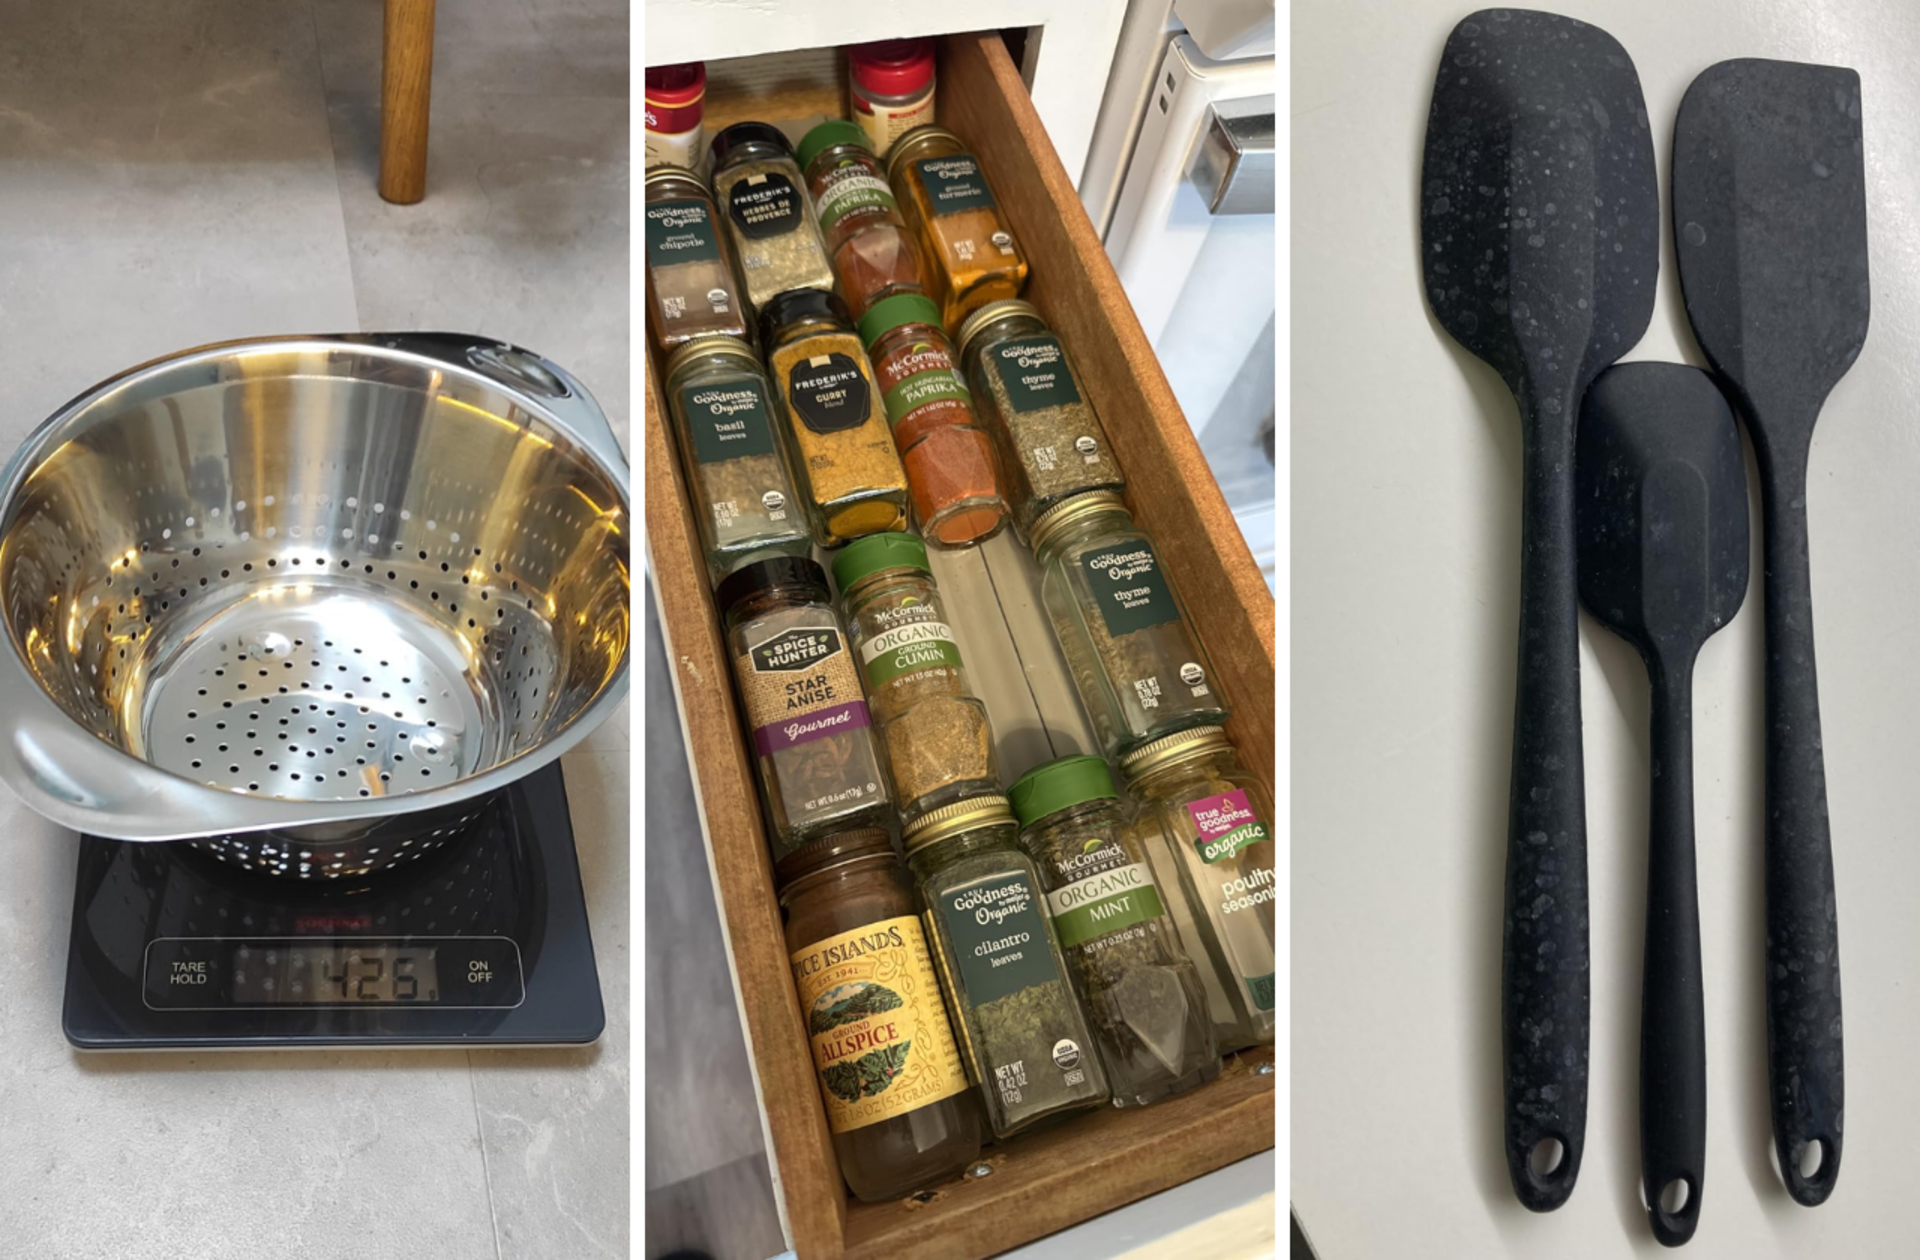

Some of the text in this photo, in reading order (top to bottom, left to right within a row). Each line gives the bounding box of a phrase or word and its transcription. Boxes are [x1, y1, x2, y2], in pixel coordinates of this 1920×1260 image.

[734, 186, 791, 206] FREDERIK'S
[821, 178, 876, 206] ORGANIC
[939, 188, 981, 200] turmeric
[778, 199, 790, 208] DE
[834, 193, 881, 214] PAPRIKA
[747, 208, 791, 225] PROVENCE
[659, 239, 705, 250] chipotle
[1001, 345, 1053, 358] Goodness
[886, 349, 950, 376] McCormick
[1018, 356, 1057, 368] Organic
[795, 371, 858, 391] FREDERIK'S
[1021, 373, 1055, 385] thyme
[693, 391, 753, 405] Goodness
[815, 389, 847, 403] CURRY
[905, 382, 958, 403] PAPRIKA
[710, 402, 755, 416] Organic
[714, 420, 745, 432] basil
[718, 432, 747, 442] leaves
[1090, 550, 1147, 569] Goodness
[1108, 564, 1152, 580] Organic
[1114, 586, 1151, 601] thyme
[1123, 597, 1150, 609] leaves
[874, 603, 935, 624] McCormick
[774, 636, 817, 655] SPICE
[873, 624, 949, 652] ORGANIC
[767, 644, 828, 668] HUNTER
[897, 641, 936, 656] GROUND
[894, 649, 945, 668] CUMIN
[785, 674, 828, 696] STAR
[786, 686, 837, 710] ANISE
[784, 710, 851, 741] Gourmet
[805, 800, 816, 810] NET
[1195, 808, 1219, 821] true
[1199, 808, 1251, 832] goodness
[1205, 823, 1265, 858] organic
[1056, 842, 1122, 874] McCormick
[1067, 859, 1122, 882] GOURMET
[954, 883, 1023, 911] Goodness
[1059, 867, 1142, 908] ORGANIC
[1222, 885, 1276, 914] seasoni
[975, 901, 1028, 925] Organic
[1089, 896, 1131, 923] MINT
[821, 925, 904, 968] ISLANDS
[974, 932, 1030, 957] cilantro
[1096, 939, 1107, 949] WT
[172, 961, 206, 973] TARE
[468, 960, 489, 972] ON
[990, 951, 1024, 968] leaves
[170, 973, 207, 985] HOLD
[467, 971, 493, 984] OFF
[835, 967, 859, 978] 1941
[832, 1021, 871, 1039] GROUND
[822, 1022, 899, 1063] ALLSPICE
[995, 1060, 1024, 1080] NET WT
[999, 1072, 1028, 1092] 0.42 OZ
[1002, 1087, 1022, 1107] (12g)
